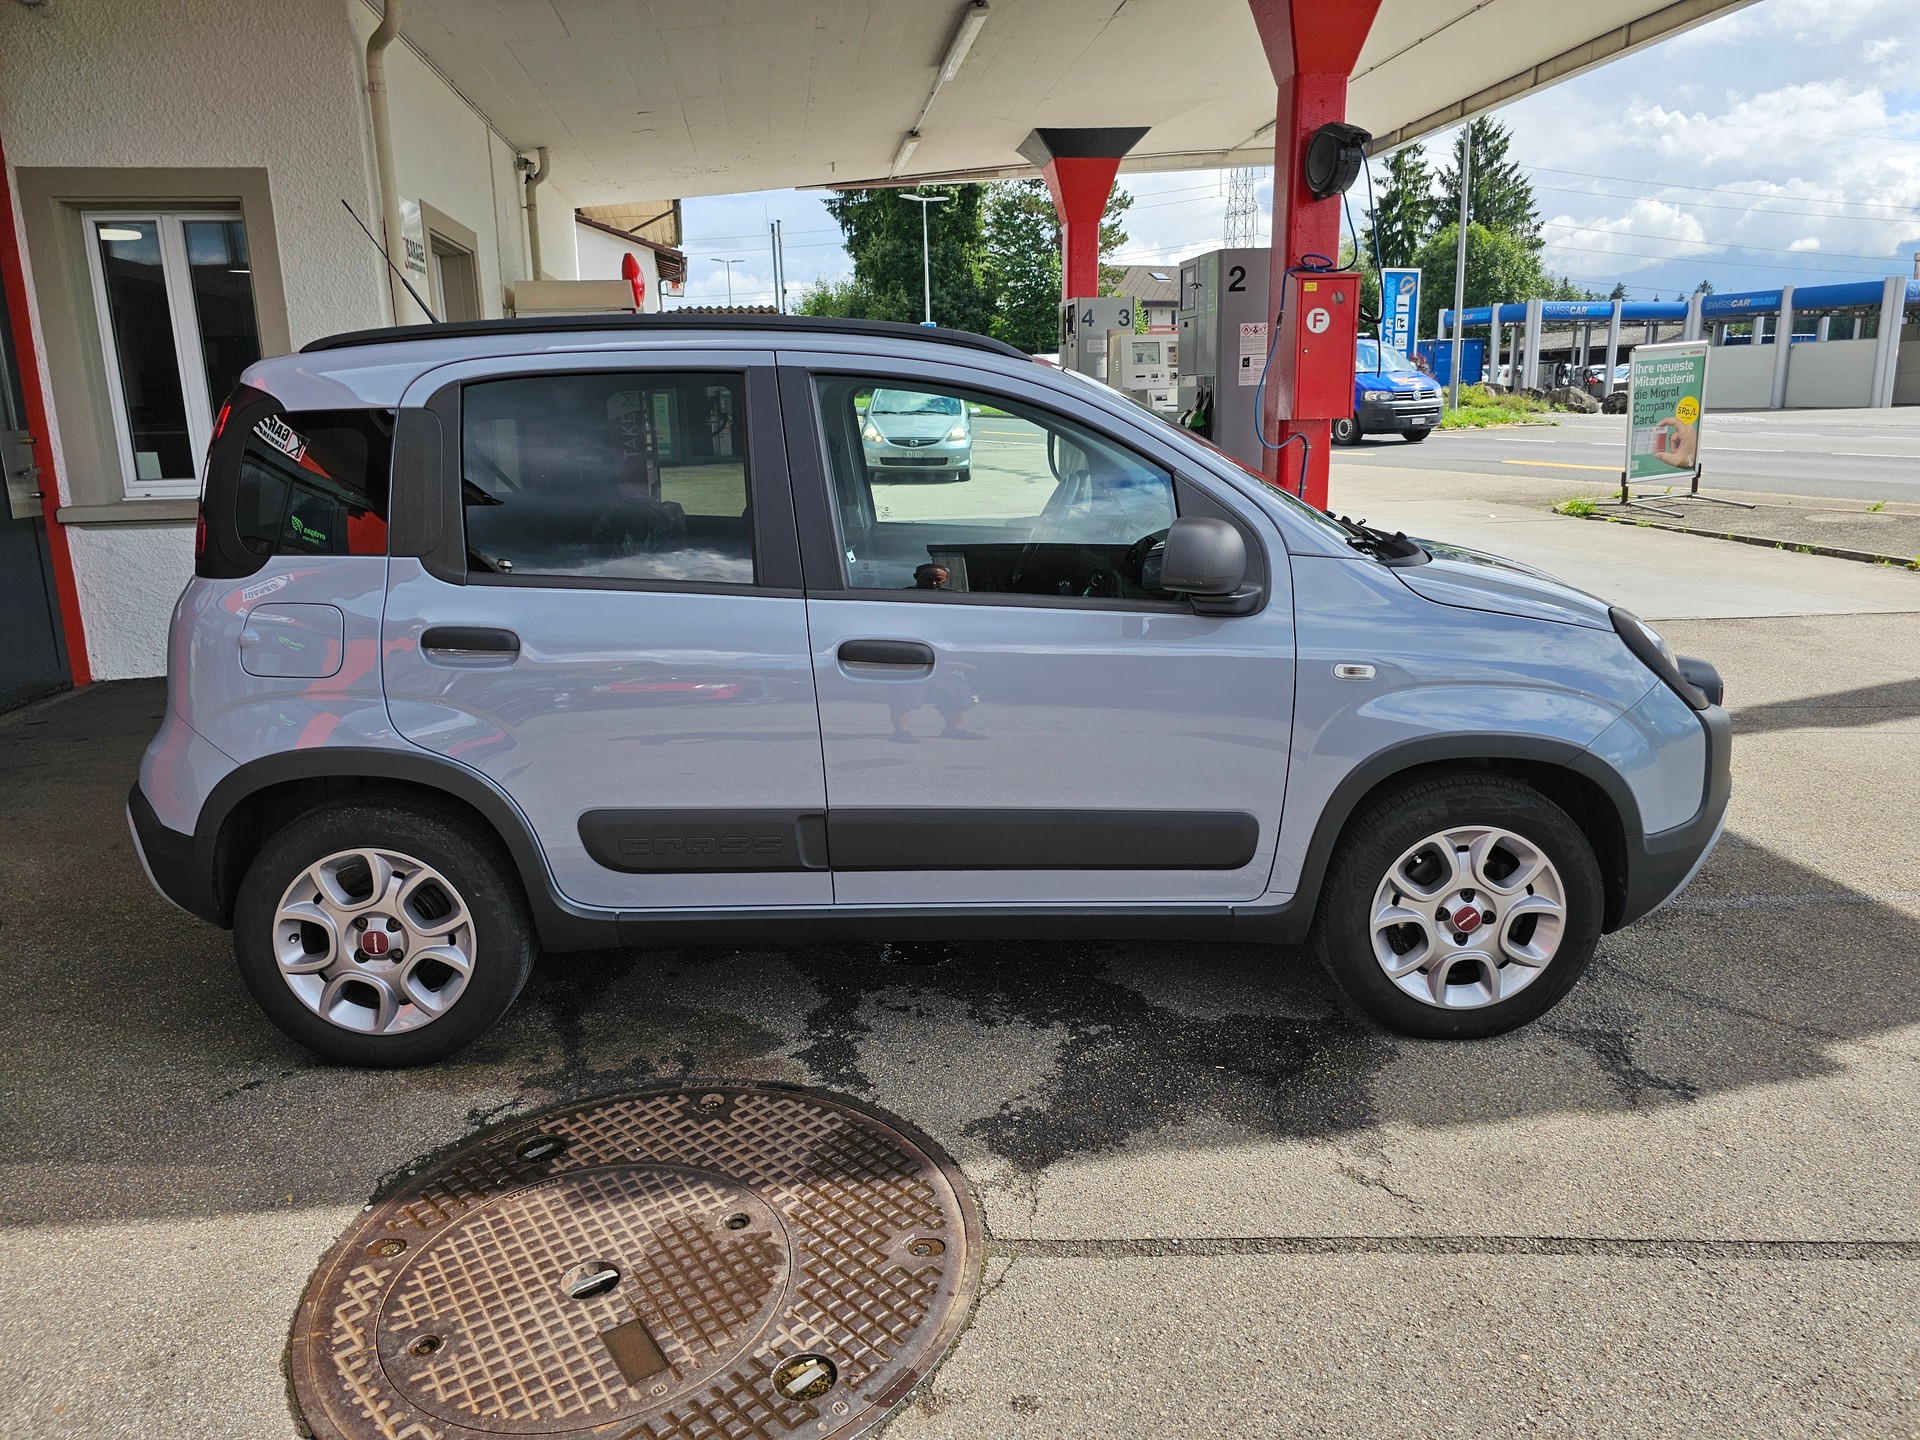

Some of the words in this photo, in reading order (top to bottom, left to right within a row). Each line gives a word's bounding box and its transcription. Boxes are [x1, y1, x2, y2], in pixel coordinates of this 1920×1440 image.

[1228, 265, 1247, 292] 2
[1081, 308, 1095, 327] 4
[1118, 308, 1131, 327] 3
[1312, 312, 1325, 329] F
[1635, 363, 1654, 374] Ihre
[1656, 360, 1694, 373] neueste
[1634, 372, 1695, 388] Mitarbeiterin
[1634, 389, 1648, 400] die
[1650, 386, 1680, 400] Migrol
[1633, 400, 1676, 414] Company
[1633, 414, 1657, 426] Card.
